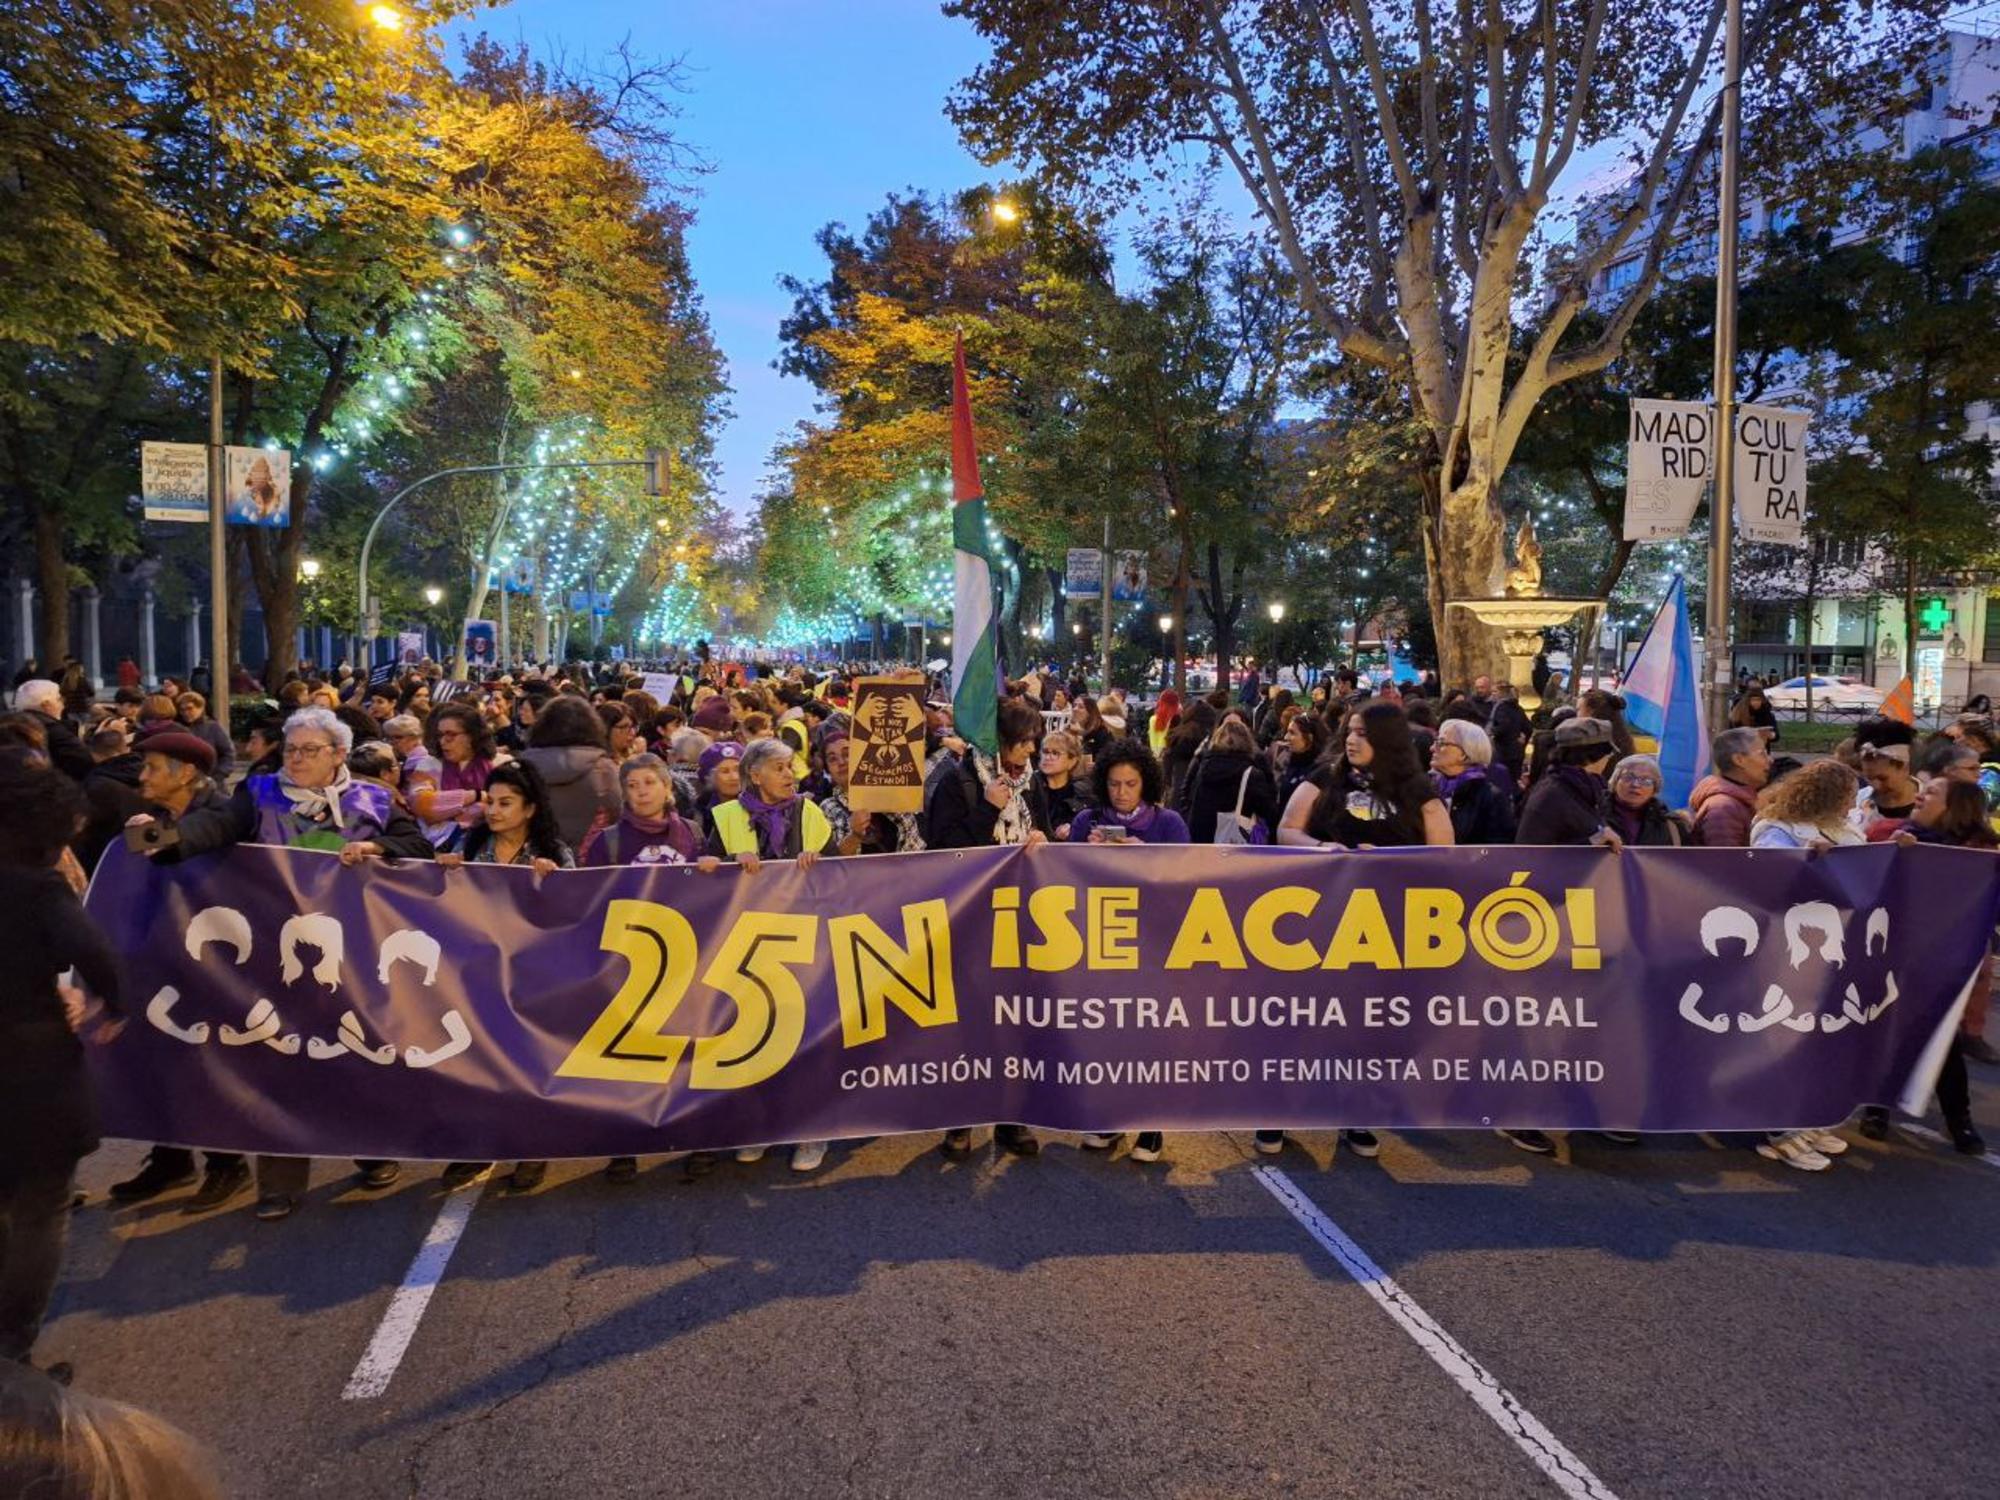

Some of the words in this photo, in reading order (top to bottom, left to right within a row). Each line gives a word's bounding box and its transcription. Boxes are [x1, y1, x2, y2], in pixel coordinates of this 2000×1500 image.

[1634, 410, 1706, 444] MAD
[1740, 415, 1795, 452] CUL
[1662, 447, 1706, 478] RID
[1749, 450, 1786, 484] TU
[1631, 479, 1672, 513] ES
[1765, 487, 1799, 521] RA
[991, 885, 1140, 972] ¡SE
[1164, 871, 1601, 972] ACABÓ!
[994, 995, 1190, 1029] NUESTRA
[1205, 996, 1347, 1028] LUCHA
[1364, 996, 1411, 1028] ES
[1426, 995, 1598, 1028] GLOBAL
[840, 1054, 992, 1090] COMISIÓN
[1003, 1057, 1045, 1082] 8M
[1058, 1059, 1251, 1084] MOVIMIENTO
[1262, 1058, 1422, 1082] FEMINISTA
[1433, 1058, 1471, 1082] DE
[1483, 1059, 1604, 1083] MADRID
